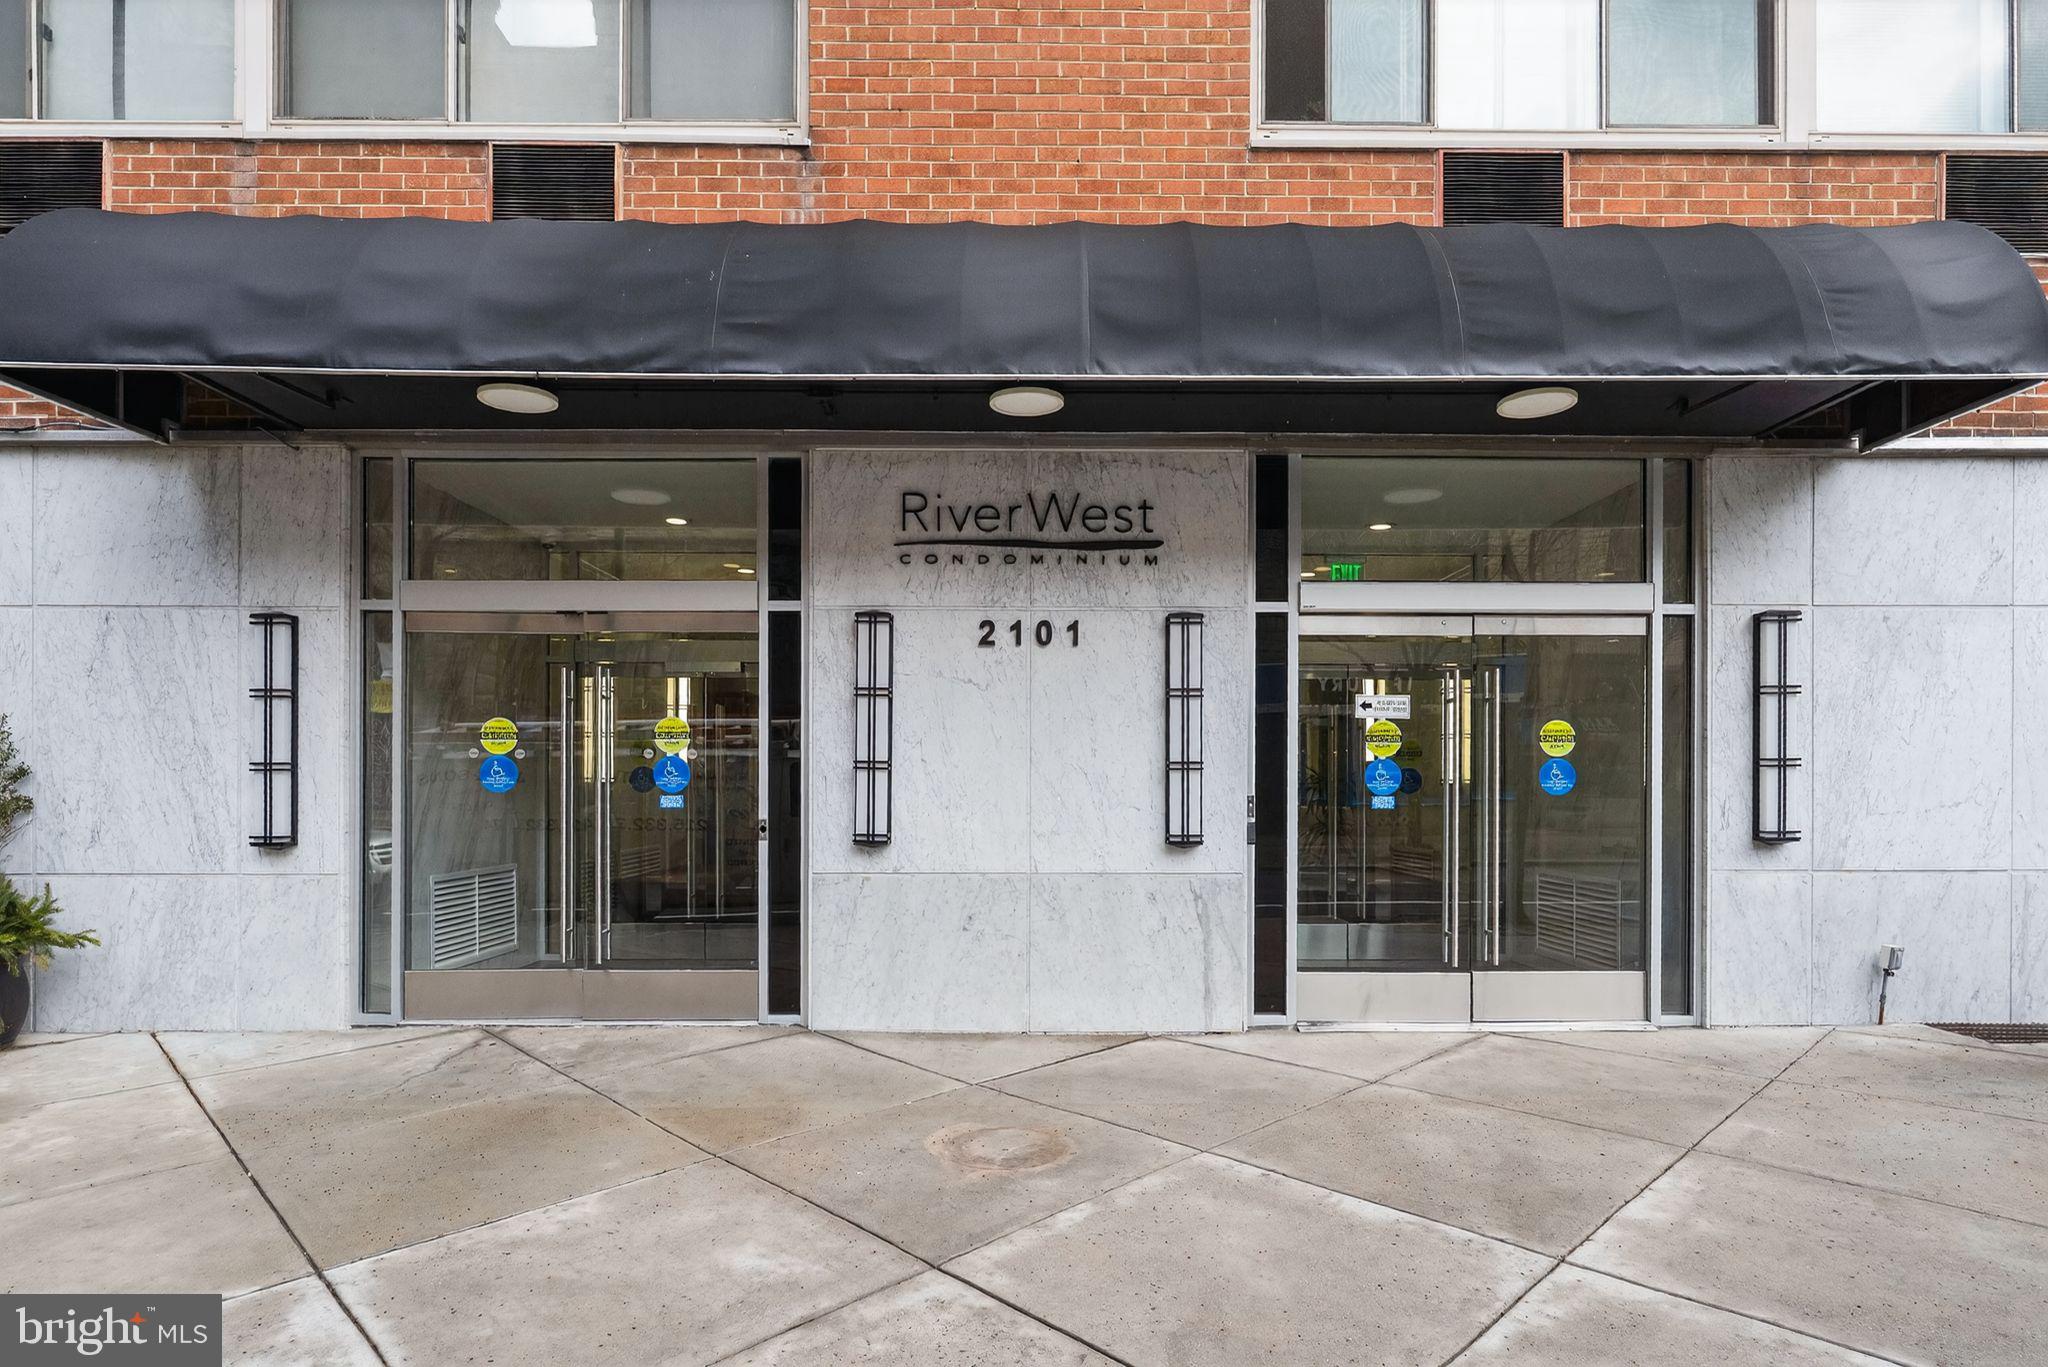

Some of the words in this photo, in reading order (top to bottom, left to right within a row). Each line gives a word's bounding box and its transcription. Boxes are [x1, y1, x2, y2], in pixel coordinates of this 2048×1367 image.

[901, 491, 1155, 534] RiverWest
[898, 553, 1159, 567] CONDOMINIUM
[977, 618, 1080, 648] 2101
